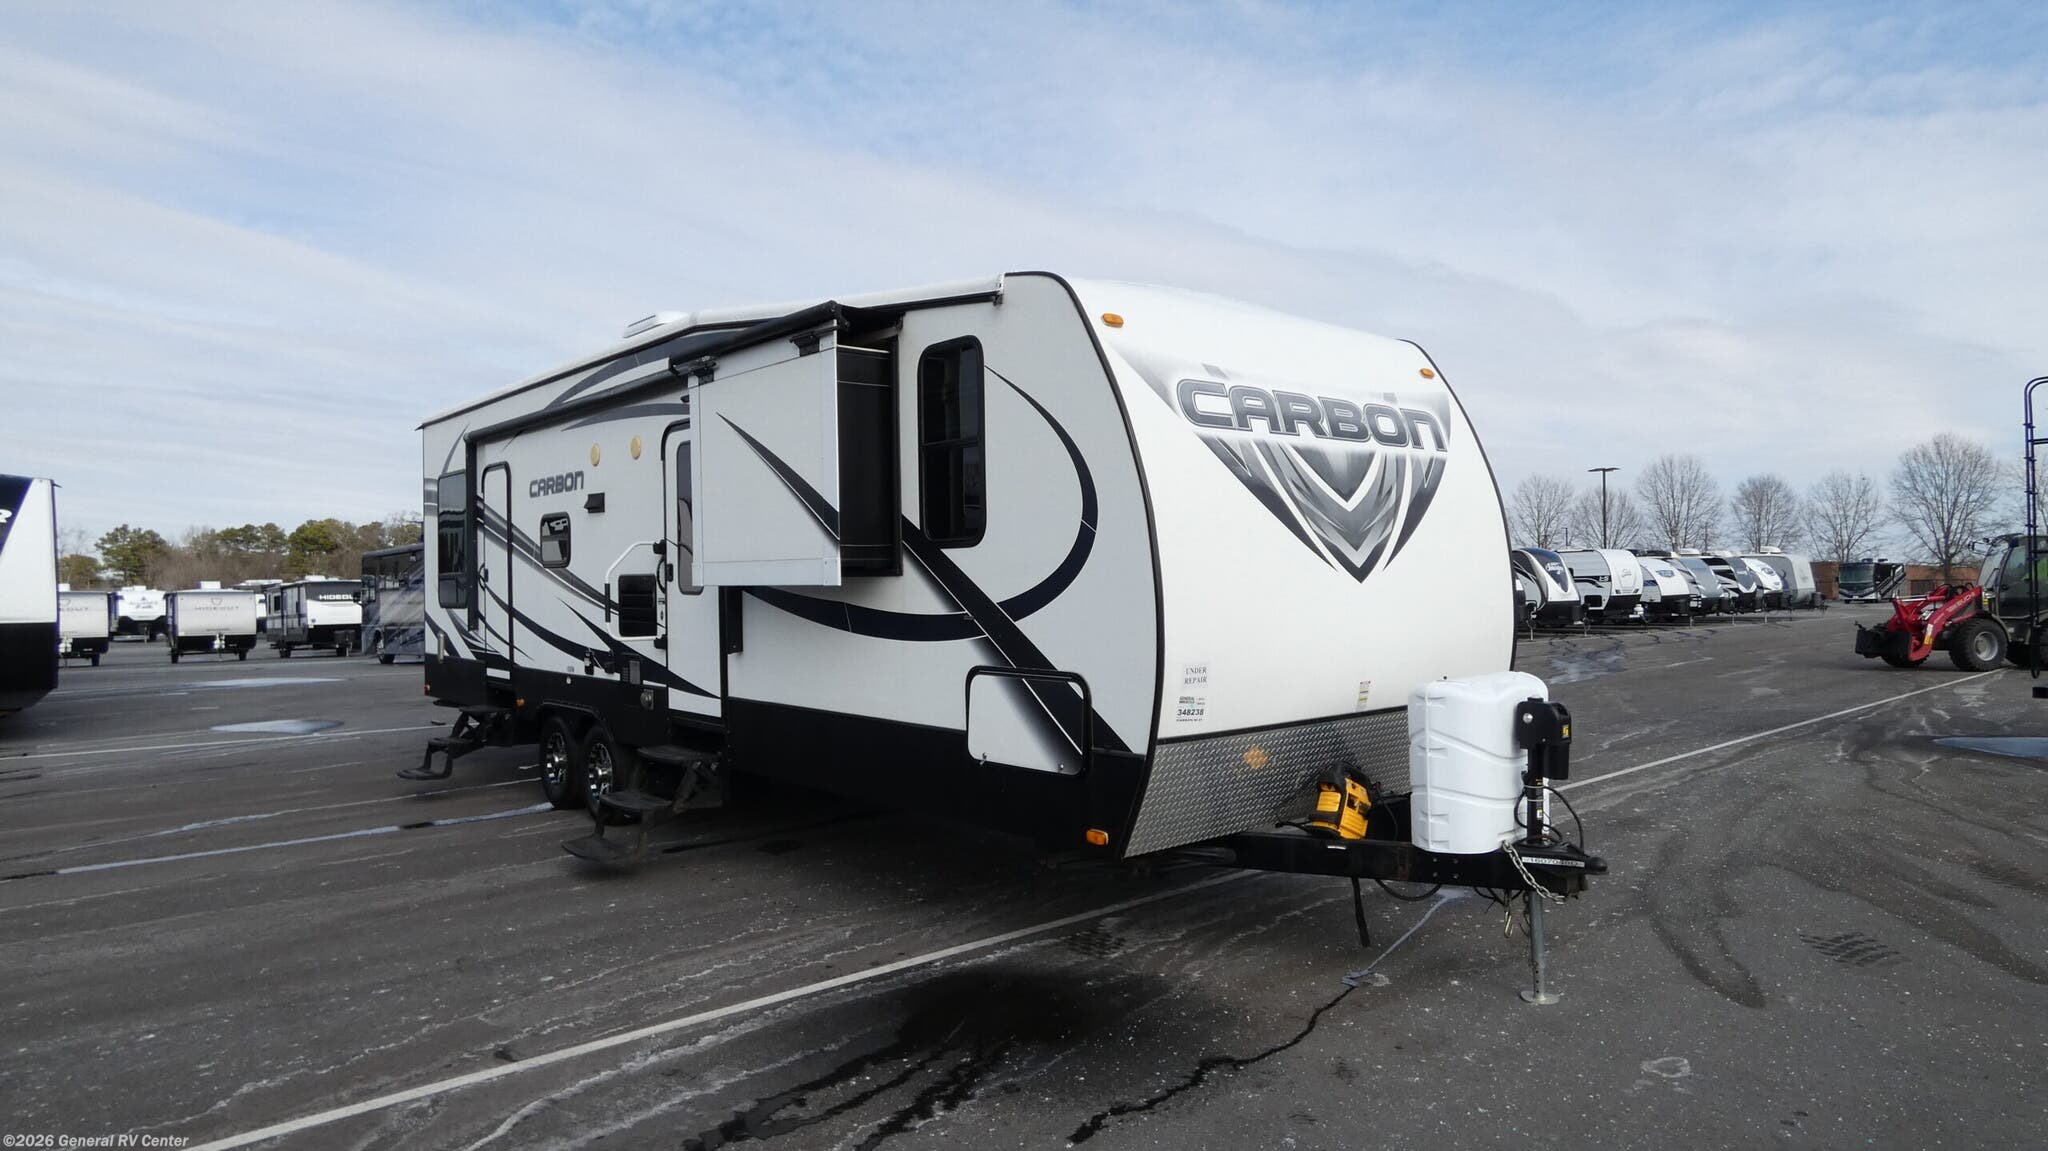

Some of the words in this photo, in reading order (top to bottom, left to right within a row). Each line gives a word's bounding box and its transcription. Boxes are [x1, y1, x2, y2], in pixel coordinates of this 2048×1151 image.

[1176, 378, 1448, 452] CARBON
[529, 470, 585, 498] CARBON
[1185, 666, 1207, 674] UNDER
[1184, 676, 1207, 685] REPAIR
